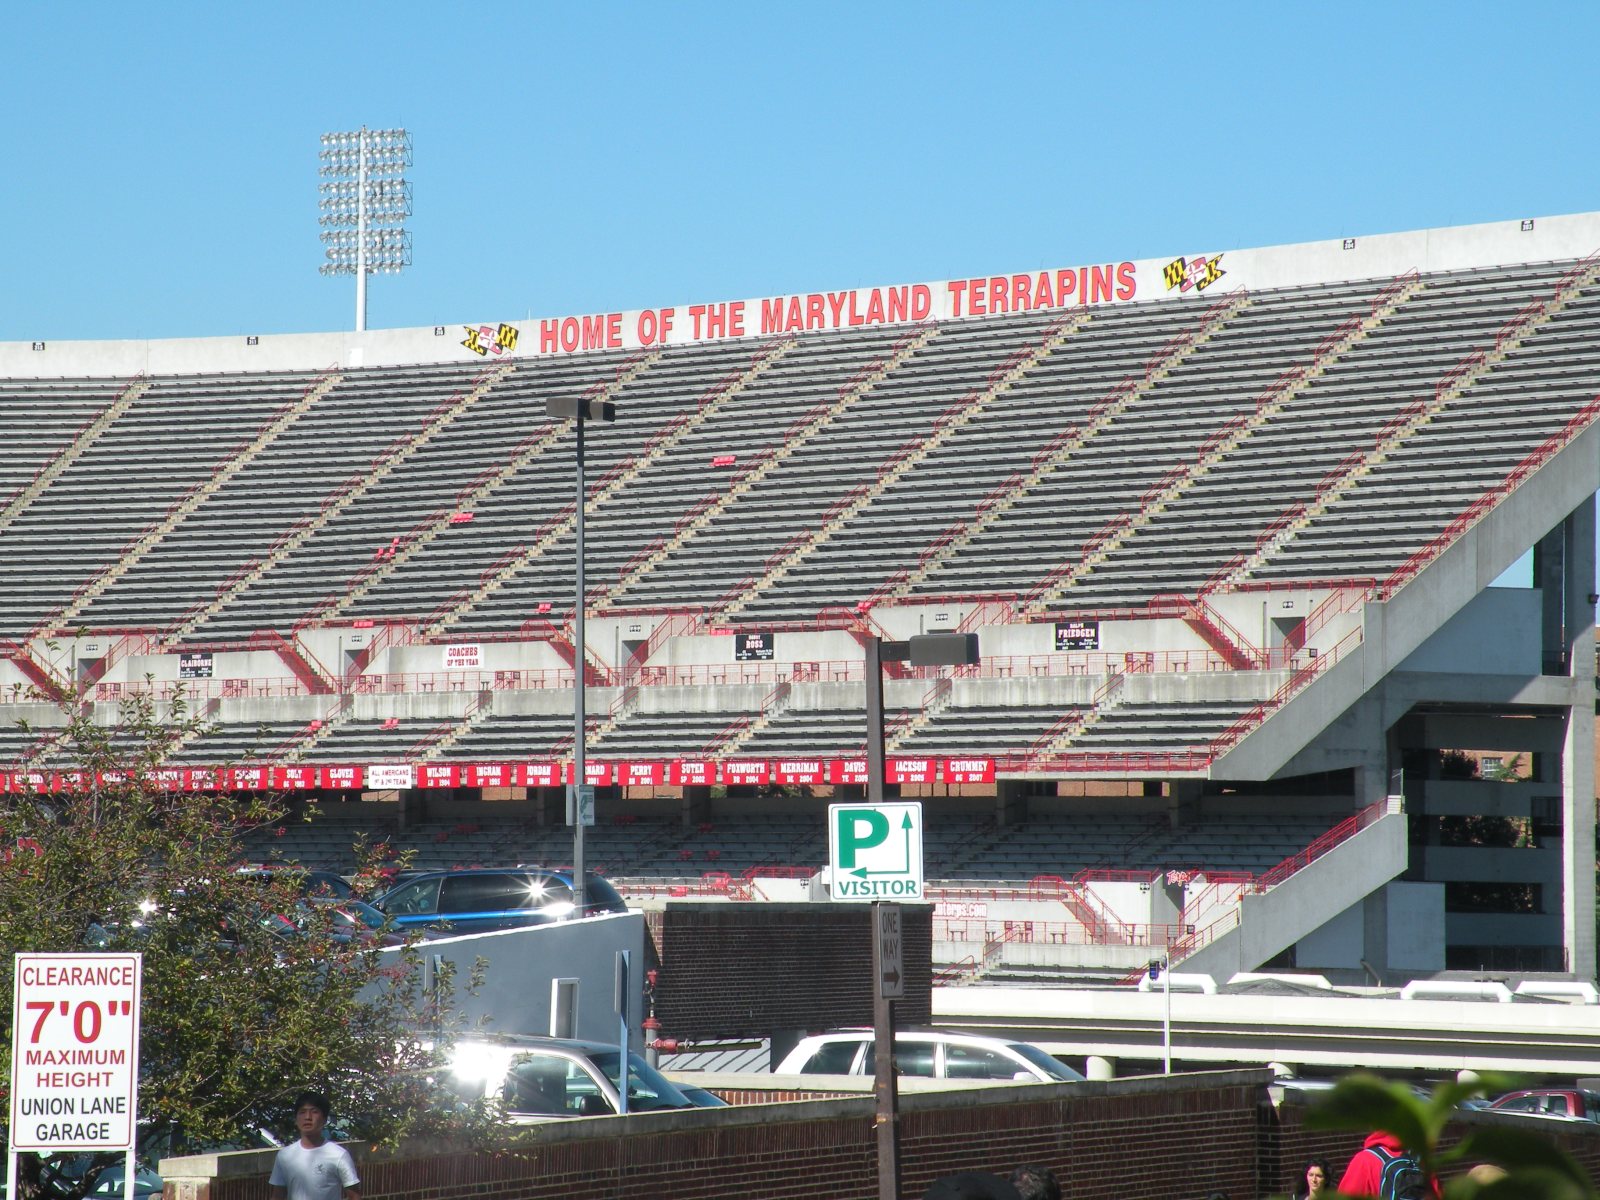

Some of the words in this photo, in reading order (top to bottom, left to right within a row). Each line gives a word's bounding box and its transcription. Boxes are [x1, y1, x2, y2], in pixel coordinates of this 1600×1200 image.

[540, 313, 622, 353] HOME
[638, 308, 674, 345] OF
[689, 302, 745, 340] THE
[761, 284, 931, 334] MARYLAND
[948, 262, 1137, 317] TERRAPINS
[1058, 629, 1096, 639] FRIEDGEN
[746, 640, 763, 649] ROSS
[448, 647, 478, 657] COACHES
[476, 766, 502, 777] INGRAM
[526, 765, 552, 776] JORDAN
[630, 764, 653, 776] PERRY
[681, 763, 705, 774] SUTER
[726, 763, 766, 774] FOXWORTH
[780, 763, 819, 774] MERRIMAN
[844, 762, 866, 773] DAVIS
[895, 761, 928, 772] JACKSON
[950, 761, 988, 772] CRUMMEY
[286, 769, 303, 779] SOLT
[329, 768, 355, 779] GLOVER
[427, 767, 452, 778] WILSON
[897, 774, 905, 782] LB
[968, 774, 983, 782] 2007
[393, 778, 407, 786] TEAM
[489, 778, 501, 786] 1995
[680, 776, 688, 784] SP
[691, 775, 706, 784] 2002
[745, 775, 759, 784] 2004
[786, 775, 794, 783] DE
[799, 775, 813, 783] 2004
[841, 775, 850, 783] TE
[838, 809, 890, 868] P
[839, 880, 917, 896] VISITOR
[934, 903, 988, 920] mterps.com
[882, 912, 898, 934] ONE
[882, 939, 898, 961] WAY
[23, 966, 133, 986] CLEARANCE
[26, 1049, 125, 1065] MAXIMUM
[37, 1072, 114, 1088] HEIGHT
[21, 1097, 75, 1116] UNION
[81, 1096, 126, 1115] LANE
[36, 1122, 110, 1141] GARAGE
